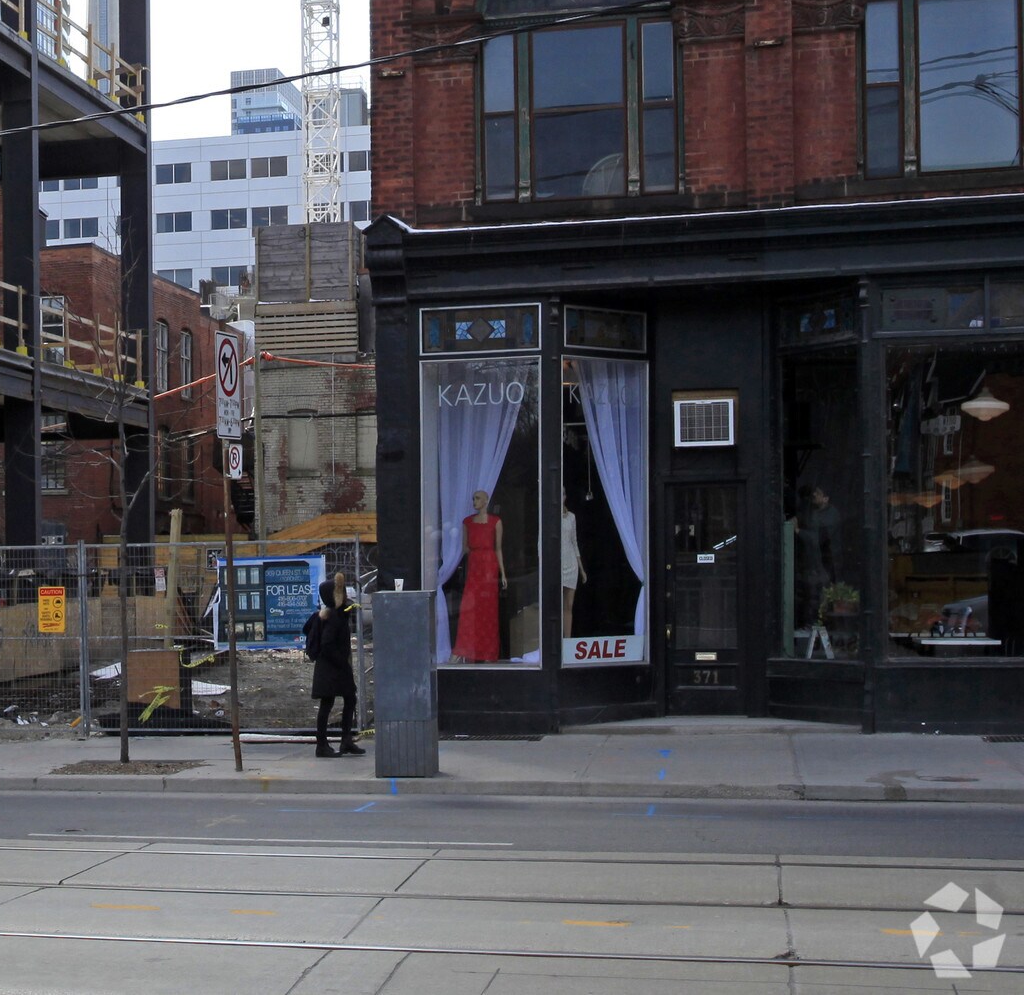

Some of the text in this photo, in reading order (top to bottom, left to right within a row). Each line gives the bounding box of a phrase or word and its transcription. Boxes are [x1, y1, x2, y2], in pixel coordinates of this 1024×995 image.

[438, 381, 525, 406] KAZUO
[266, 584, 317, 596] FOR LEASE
[574, 639, 627, 660] SALE
[693, 670, 719, 684] 371
